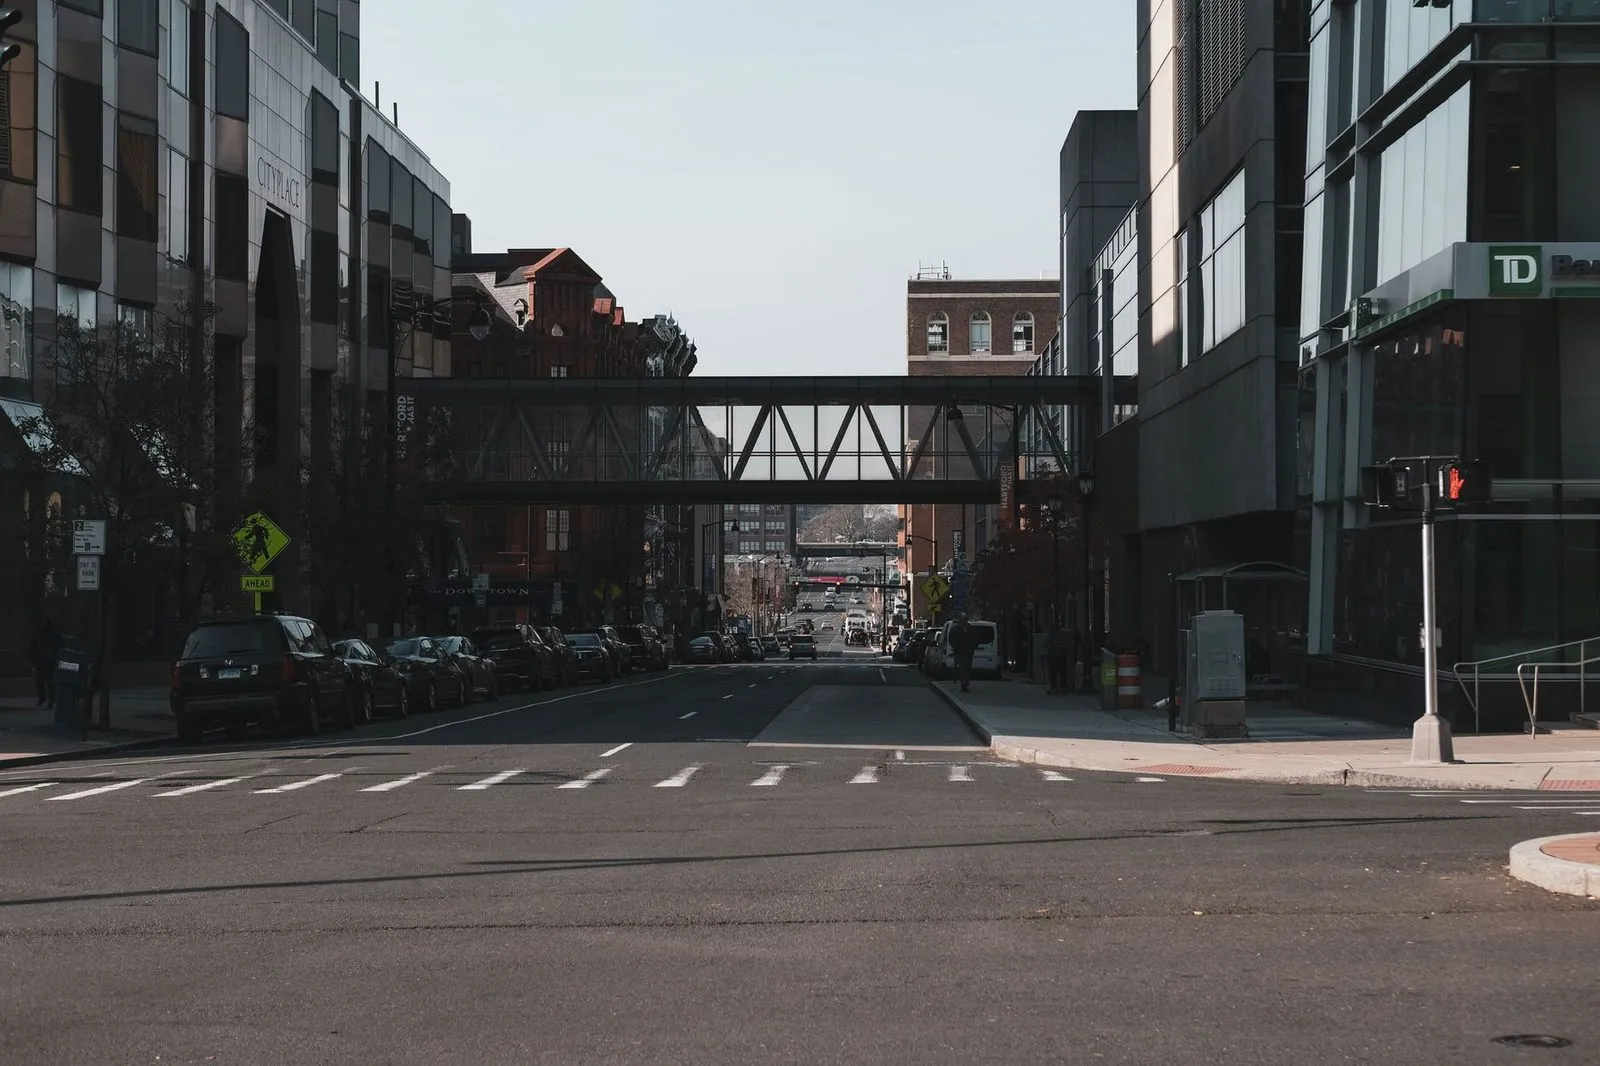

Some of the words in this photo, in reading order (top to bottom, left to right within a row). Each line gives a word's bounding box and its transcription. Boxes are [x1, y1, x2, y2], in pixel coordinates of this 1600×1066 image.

[257, 157, 299, 208] CITYPLACE
[1494, 255, 1537, 284] TD
[397, 395, 407, 460] RFORD
[1000, 465, 1008, 509] HARTFORD
[244, 579, 271, 588] AHEAD
[446, 587, 529, 595] DOWTOWN
